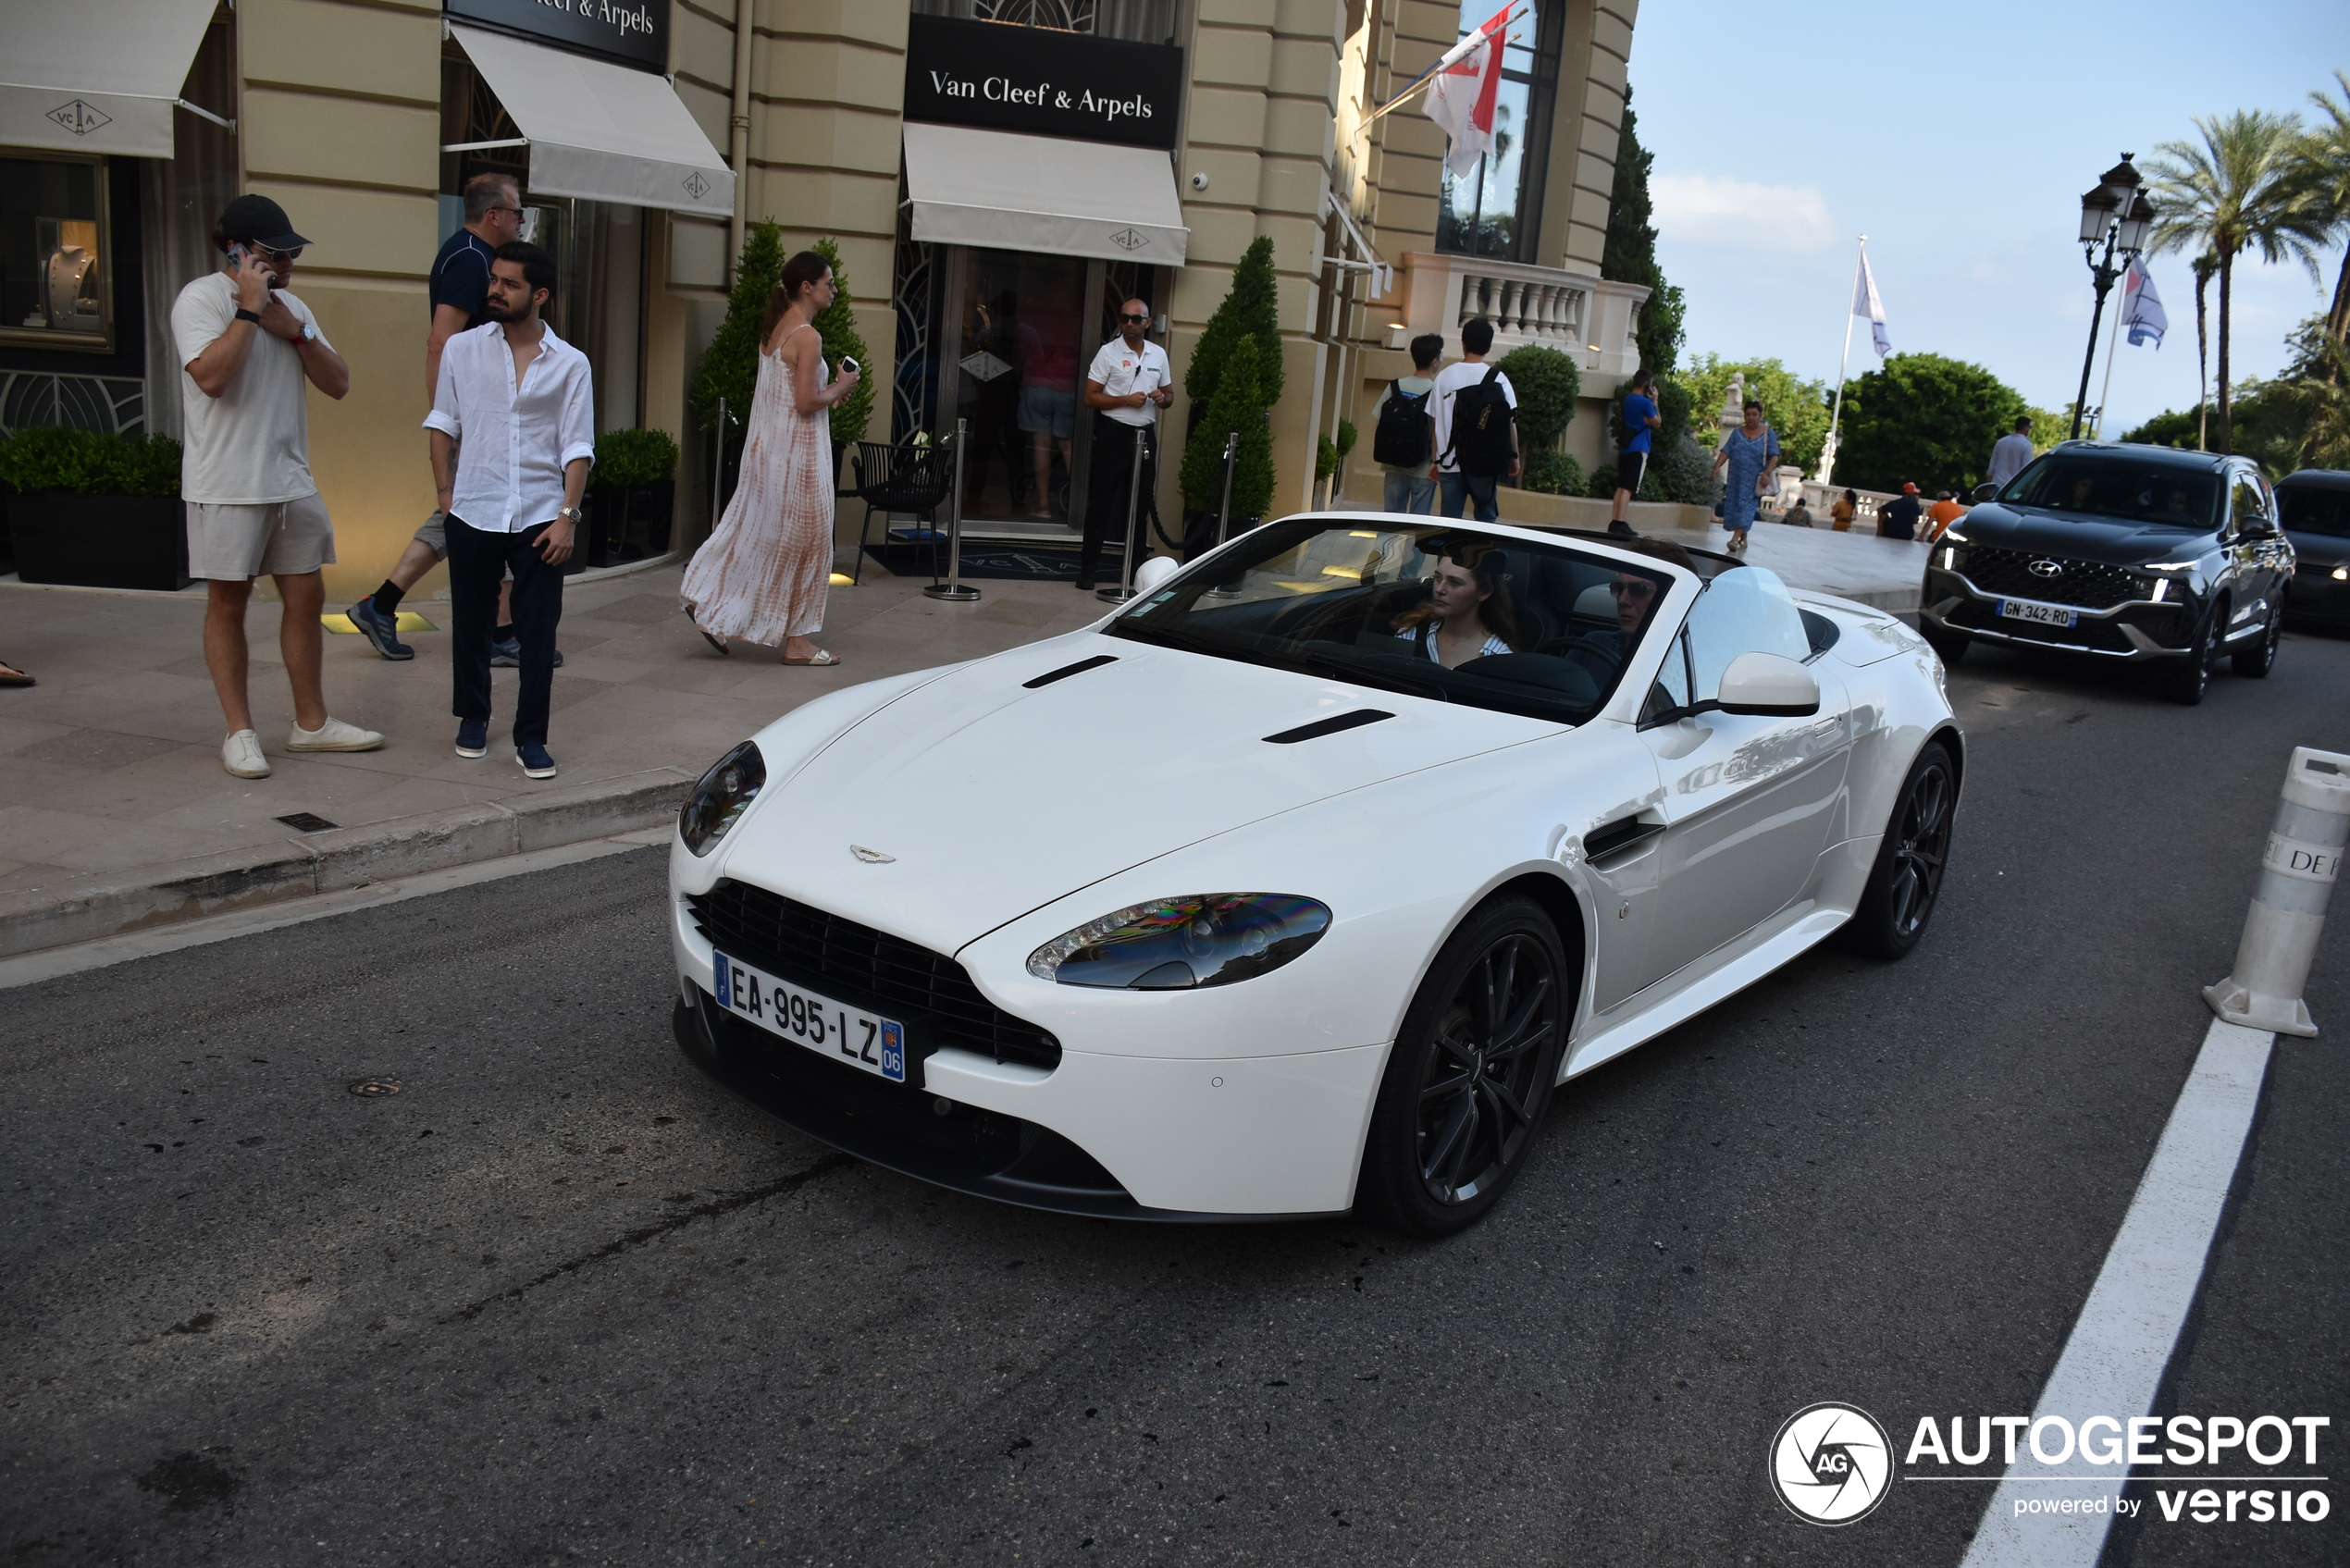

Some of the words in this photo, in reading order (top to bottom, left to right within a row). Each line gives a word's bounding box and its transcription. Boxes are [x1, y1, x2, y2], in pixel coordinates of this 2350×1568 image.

[579, 0, 593, 18] &
[597, 0, 654, 36] Arpels
[929, 70, 975, 98] Van
[983, 77, 1050, 106] Cleef
[1054, 90, 1073, 109] &
[1078, 88, 1153, 121] Arpels
[56, 112, 74, 124] VC
[85, 114, 95, 126] A
[2005, 602, 2069, 624] GN-342-RD
[2290, 849, 2327, 875] DE
[732, 965, 879, 1067] EA-995-LZ
[884, 1049, 901, 1072] 06
